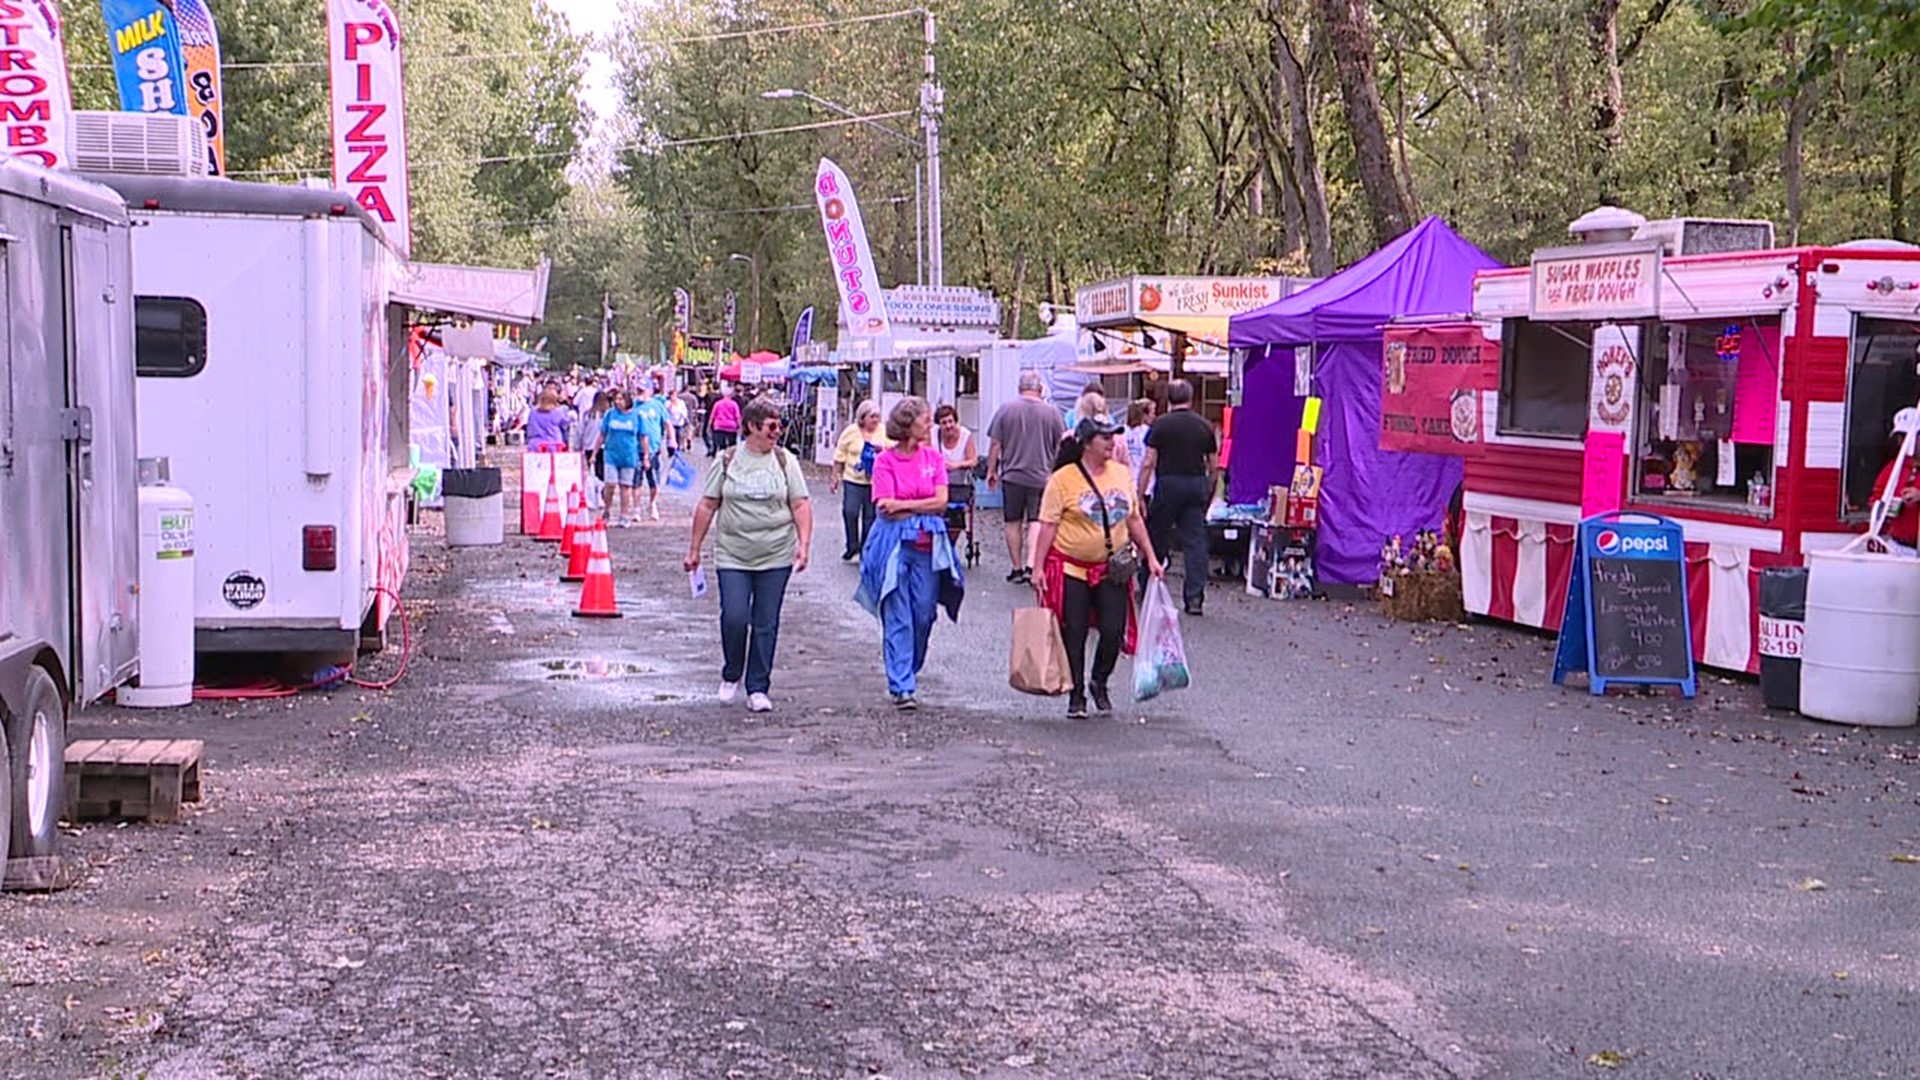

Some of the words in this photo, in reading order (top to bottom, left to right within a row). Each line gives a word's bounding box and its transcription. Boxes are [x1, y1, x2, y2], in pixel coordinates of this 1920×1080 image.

[116, 10, 166, 54] MILK
[344, 22, 396, 223] PIZZA
[1546, 263, 1581, 284] SUGAR
[1585, 259, 1642, 280] WAFFLES
[1212, 281, 1270, 300] Sunkist
[1565, 284, 1596, 305] FRIED
[1597, 282, 1637, 302] DOUGH
[917, 302, 991, 312] CONCESSIONS
[1440, 345, 1482, 365] DOUGH
[1622, 535, 1669, 553] pepsi
[224, 582, 264, 592] WELLS
[225, 591, 263, 600] CARGO
